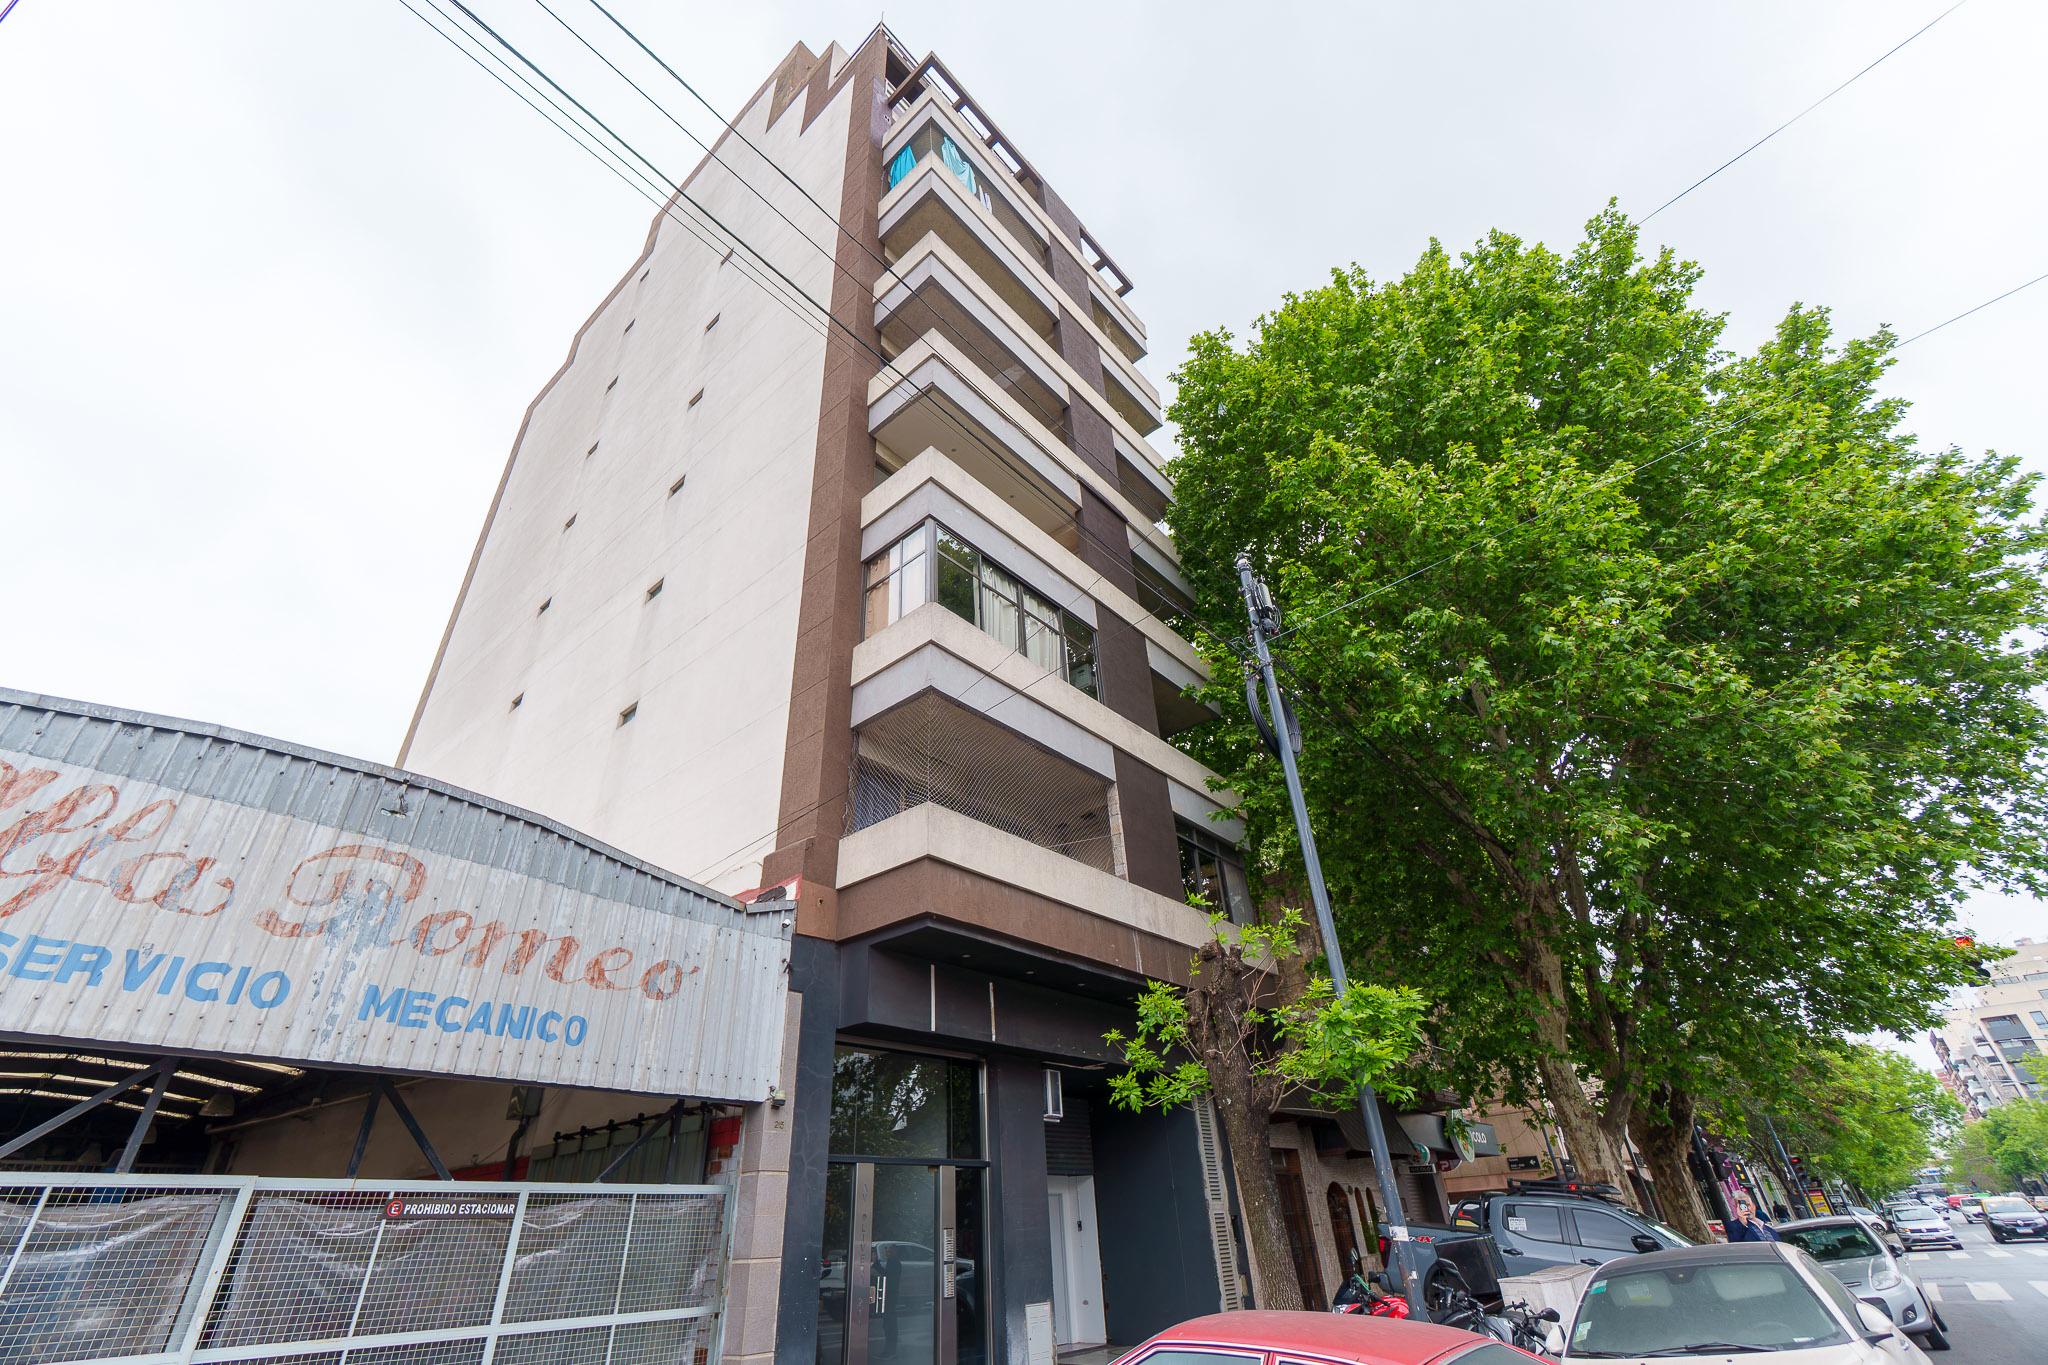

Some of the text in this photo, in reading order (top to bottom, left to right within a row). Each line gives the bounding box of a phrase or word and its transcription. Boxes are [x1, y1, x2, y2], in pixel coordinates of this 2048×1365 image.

[0, 757, 699, 1000] lfa Romeo
[357, 984, 588, 1047] MECANICO
[403, 1204, 457, 1214] PROHIBIDO
[459, 1204, 515, 1214] ESTACIONAR
